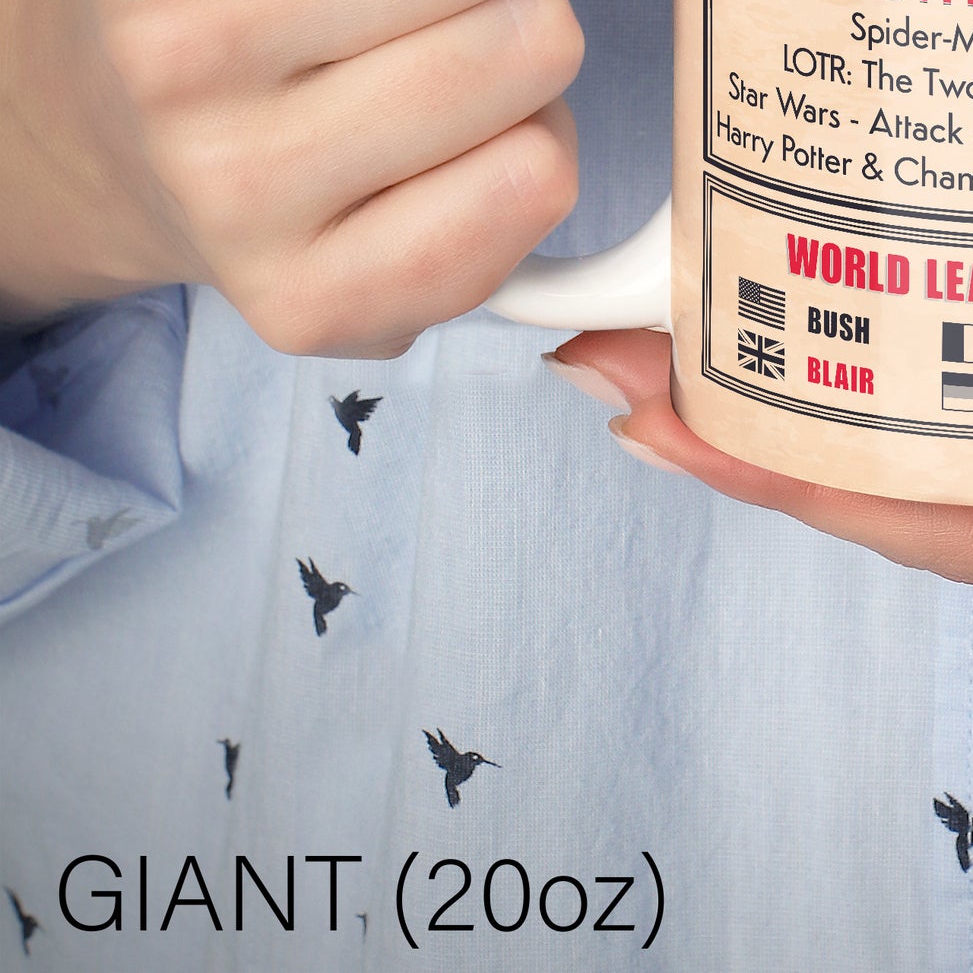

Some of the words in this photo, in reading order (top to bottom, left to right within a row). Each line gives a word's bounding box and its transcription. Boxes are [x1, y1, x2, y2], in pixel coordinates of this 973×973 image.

[783, 44, 852, 87] LOTR:
[861, 60, 912, 94] The
[728, 72, 768, 111] Star
[776, 87, 841, 130] Wars
[869, 107, 964, 146] Attack
[717, 110, 773, 164] Harry
[782, 134, 853, 177] Potter
[861, 153, 884, 182] &
[785, 233, 911, 296] WORLD
[807, 306, 870, 345] BUSH
[807, 356, 874, 395] BLAIR
